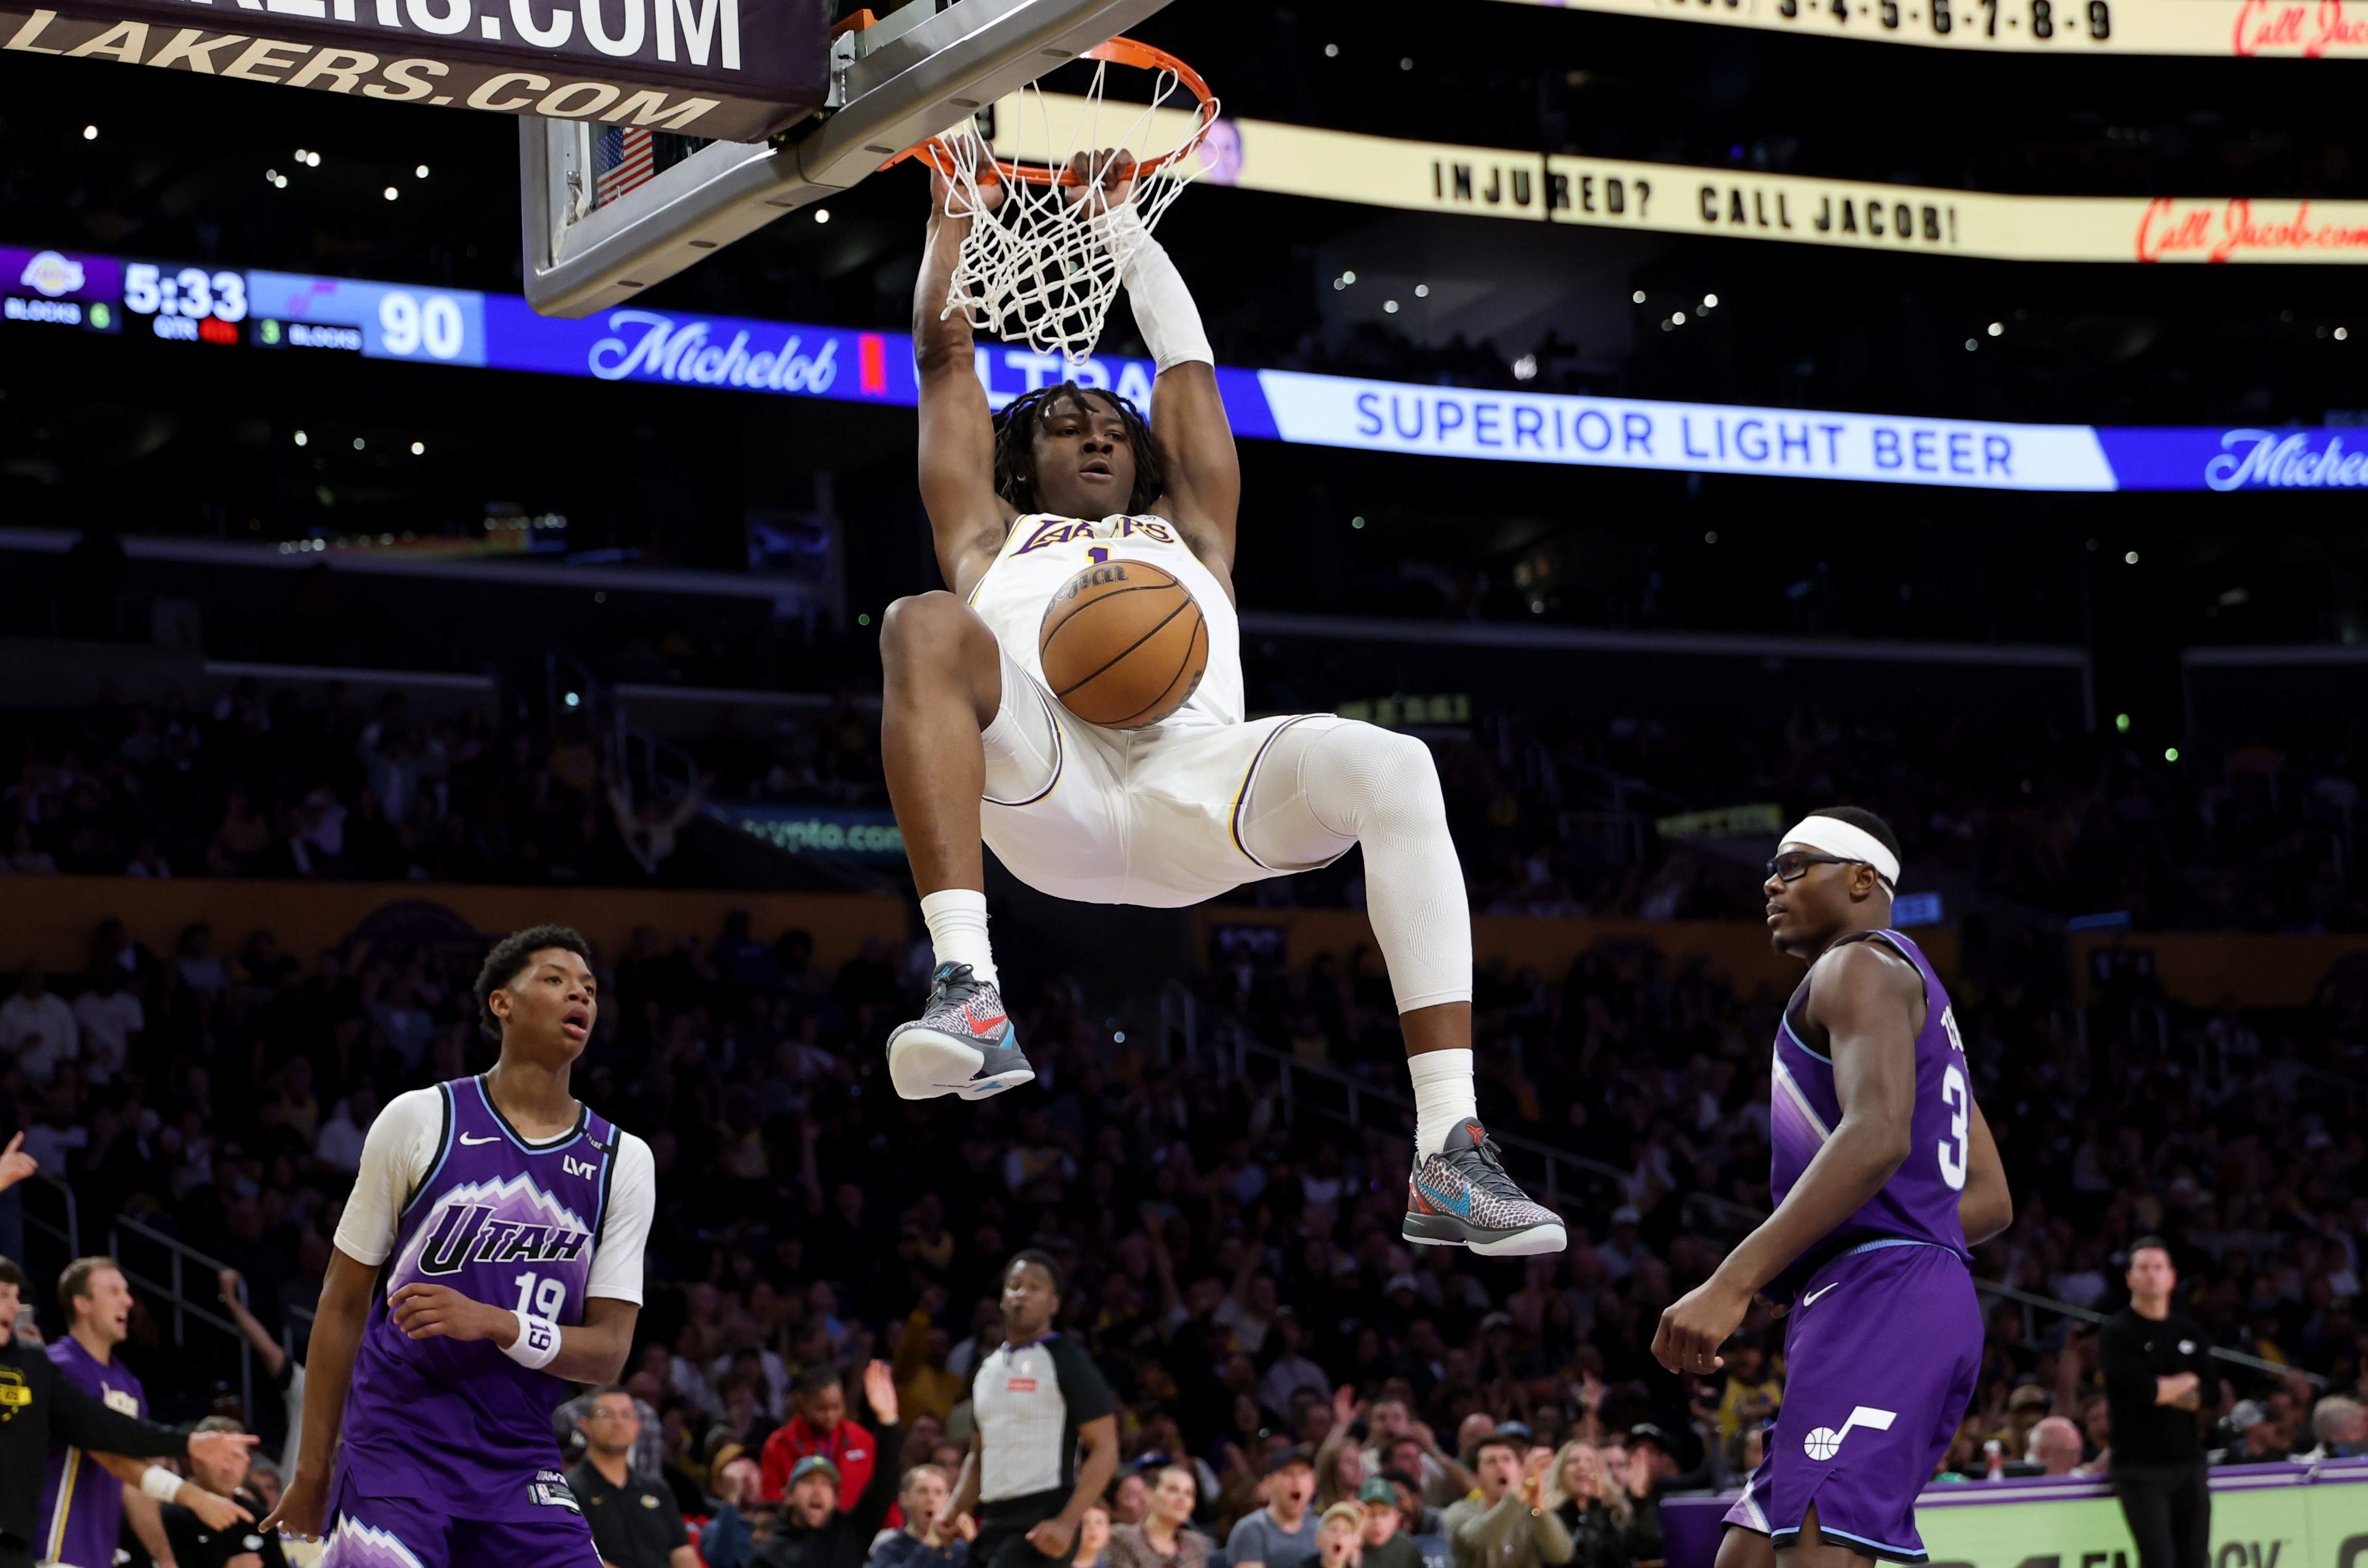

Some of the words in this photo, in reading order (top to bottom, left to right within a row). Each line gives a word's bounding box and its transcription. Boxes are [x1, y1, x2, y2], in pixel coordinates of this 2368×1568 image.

[2, 9, 721, 129] LAKERS.COM
[1432, 161, 1651, 218] INJURED?
[1699, 186, 1793, 229] CALL
[1813, 196, 1957, 242] JACOB!
[124, 263, 247, 322] 5:33
[378, 291, 465, 360] 90
[588, 309, 838, 394] Michelob
[913, 336, 1151, 414] LTRA
[1355, 392, 1653, 456] SUPERIOR
[1681, 416, 1845, 464] LIGHT
[1873, 428, 2013, 477] BEER
[2205, 429, 2368, 491] Miche
[1008, 516, 1176, 559] LAKRS
[1938, 1063, 1968, 1191] 3
[562, 1154, 597, 1180] LVT
[417, 1203, 594, 1276] UTAH
[515, 1271, 566, 1323] 19
[528, 1322, 552, 1351] 19
